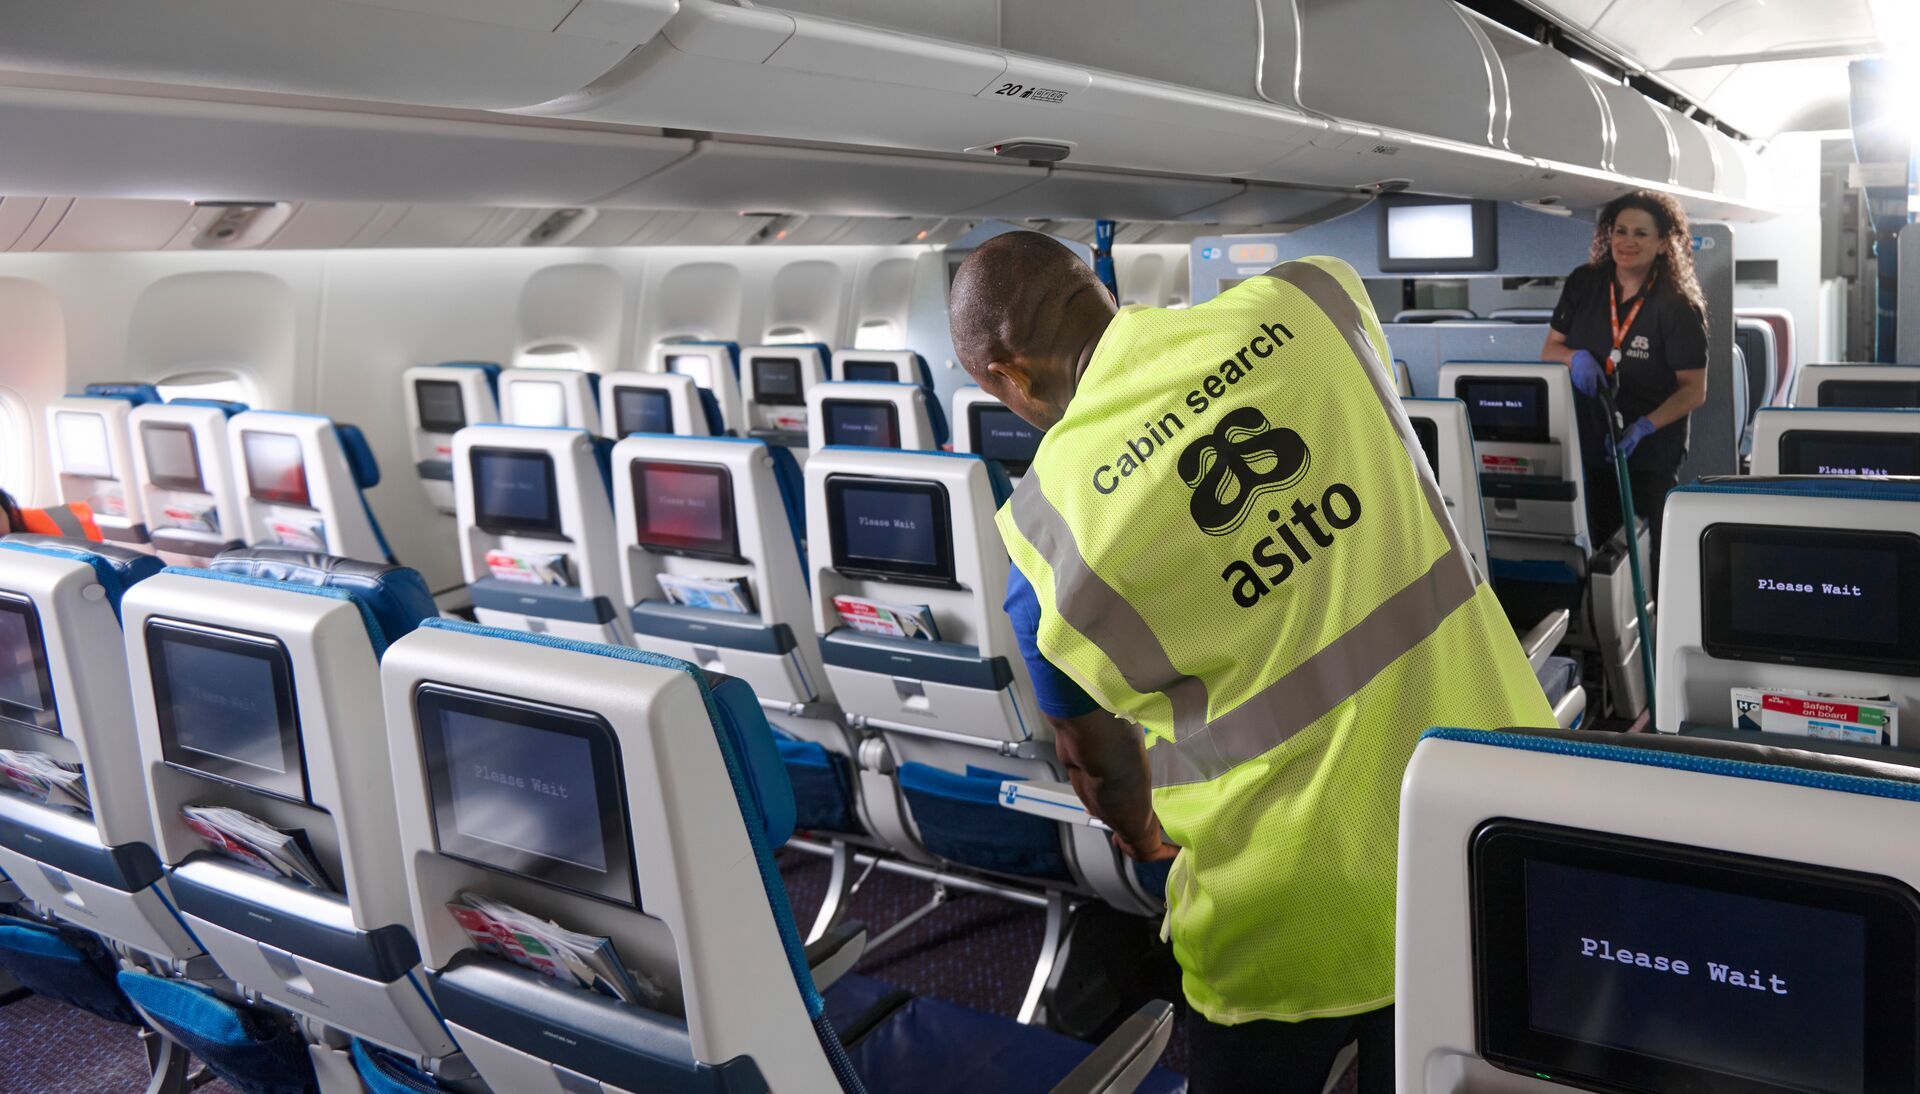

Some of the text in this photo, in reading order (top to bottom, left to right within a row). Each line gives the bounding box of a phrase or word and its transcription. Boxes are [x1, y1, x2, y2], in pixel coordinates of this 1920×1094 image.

[995, 83, 1023, 96] 20
[1626, 348, 1650, 359] asito
[1093, 322, 1295, 495] Cabin search
[1818, 466, 1888, 476] Please Wait
[858, 516, 916, 529] Please Wait
[1221, 482, 1362, 608] asito
[1758, 579, 1861, 596] Please Wait
[1802, 701, 1835, 712] Safety
[1818, 710, 1847, 720] board
[474, 764, 569, 798] Please Wait
[1581, 937, 1788, 995] Please Wait
